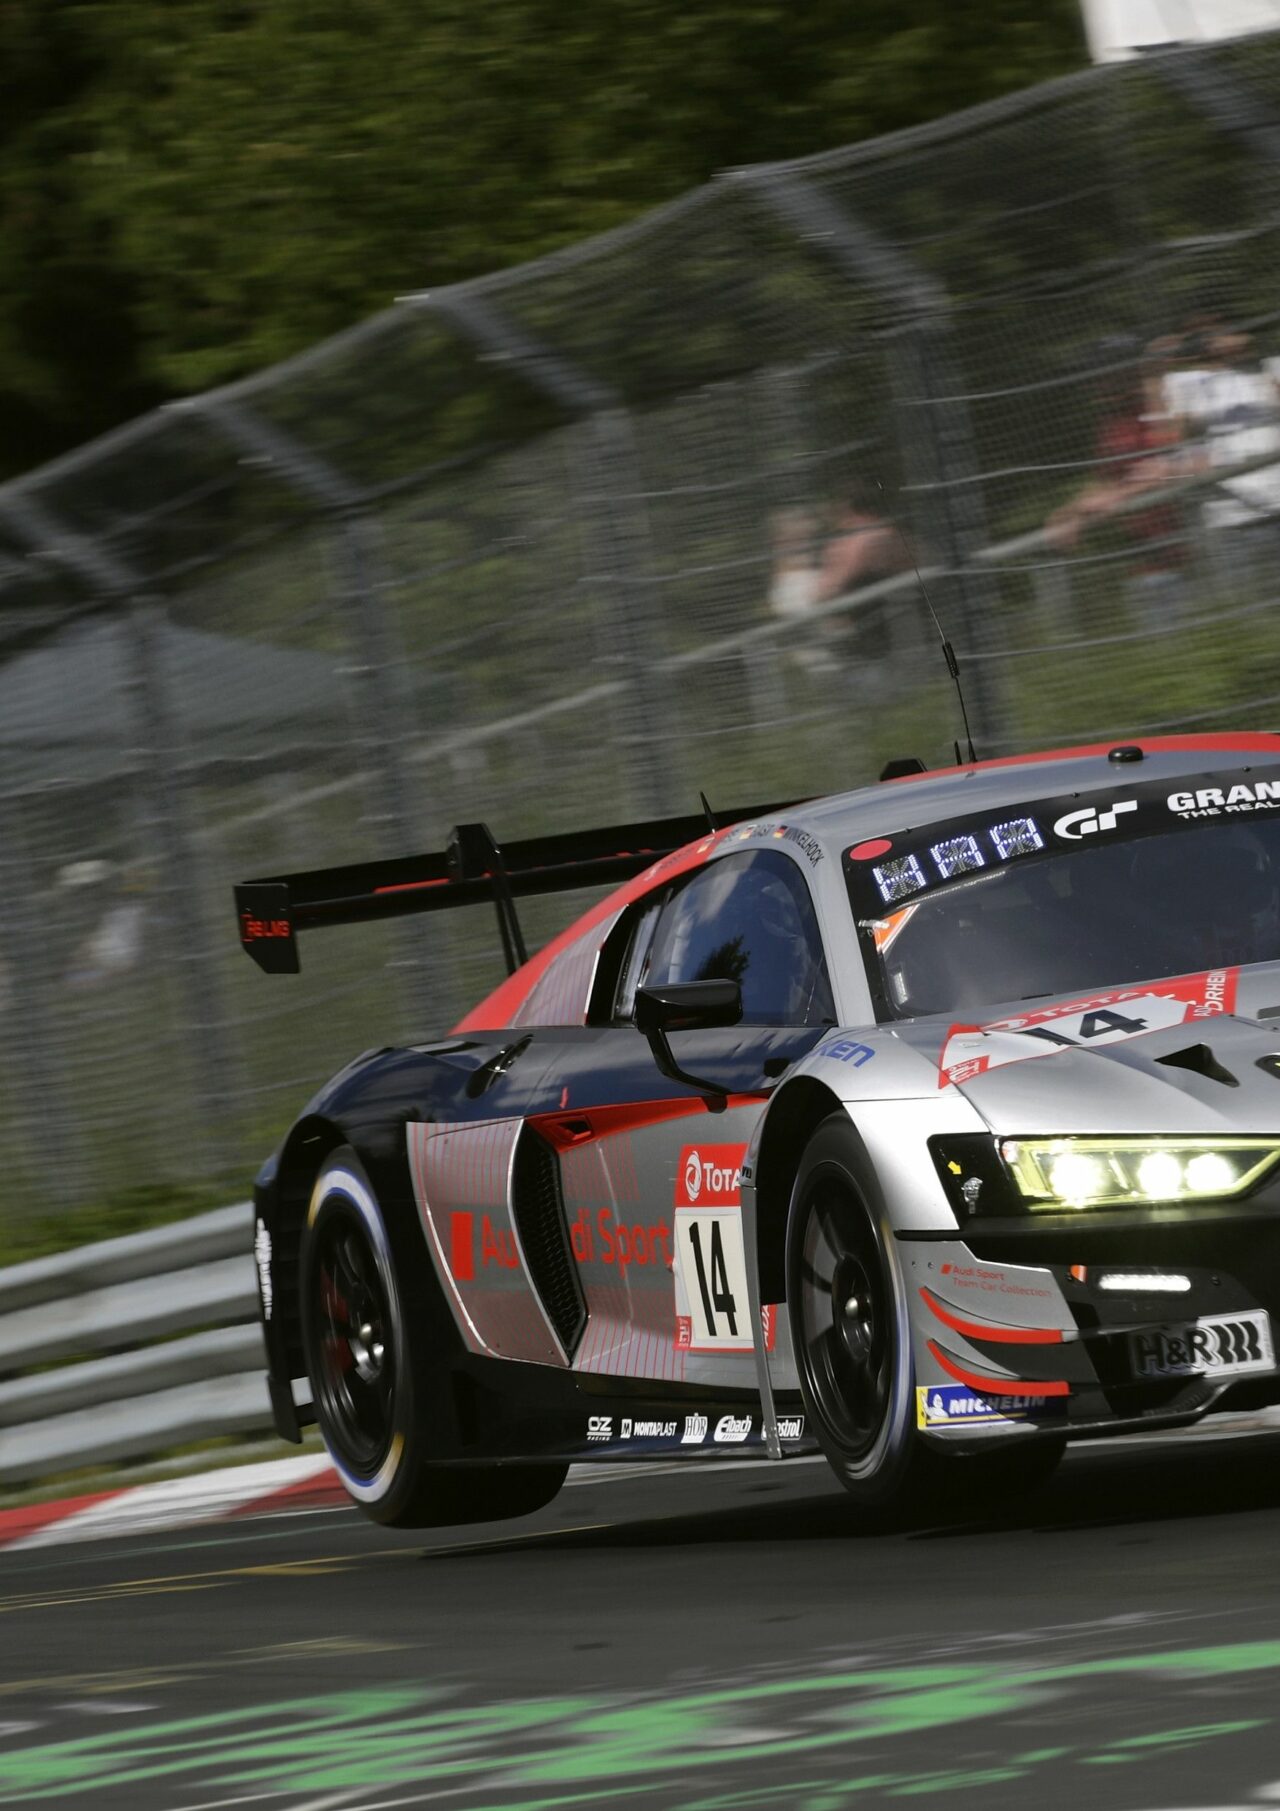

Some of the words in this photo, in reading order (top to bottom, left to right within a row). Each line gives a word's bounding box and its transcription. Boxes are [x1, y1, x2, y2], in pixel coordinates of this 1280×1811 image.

[1053, 799, 1138, 839] GT
[1178, 806, 1221, 819] THE
[599, 1208, 675, 1279] Sport
[689, 1221, 739, 1337] 14
[953, 1265, 974, 1277] Audi
[976, 1268, 1005, 1281] Sport
[953, 1277, 977, 1289] Team
[1000, 1283, 1052, 1298] Collection
[1136, 1326, 1213, 1375] H&R
[949, 1394, 1047, 1415] MICHELIN
[588, 1416, 612, 1431] OZ
[633, 1421, 677, 1437] MONTAPLAST
[721, 1415, 752, 1433] Eibach
